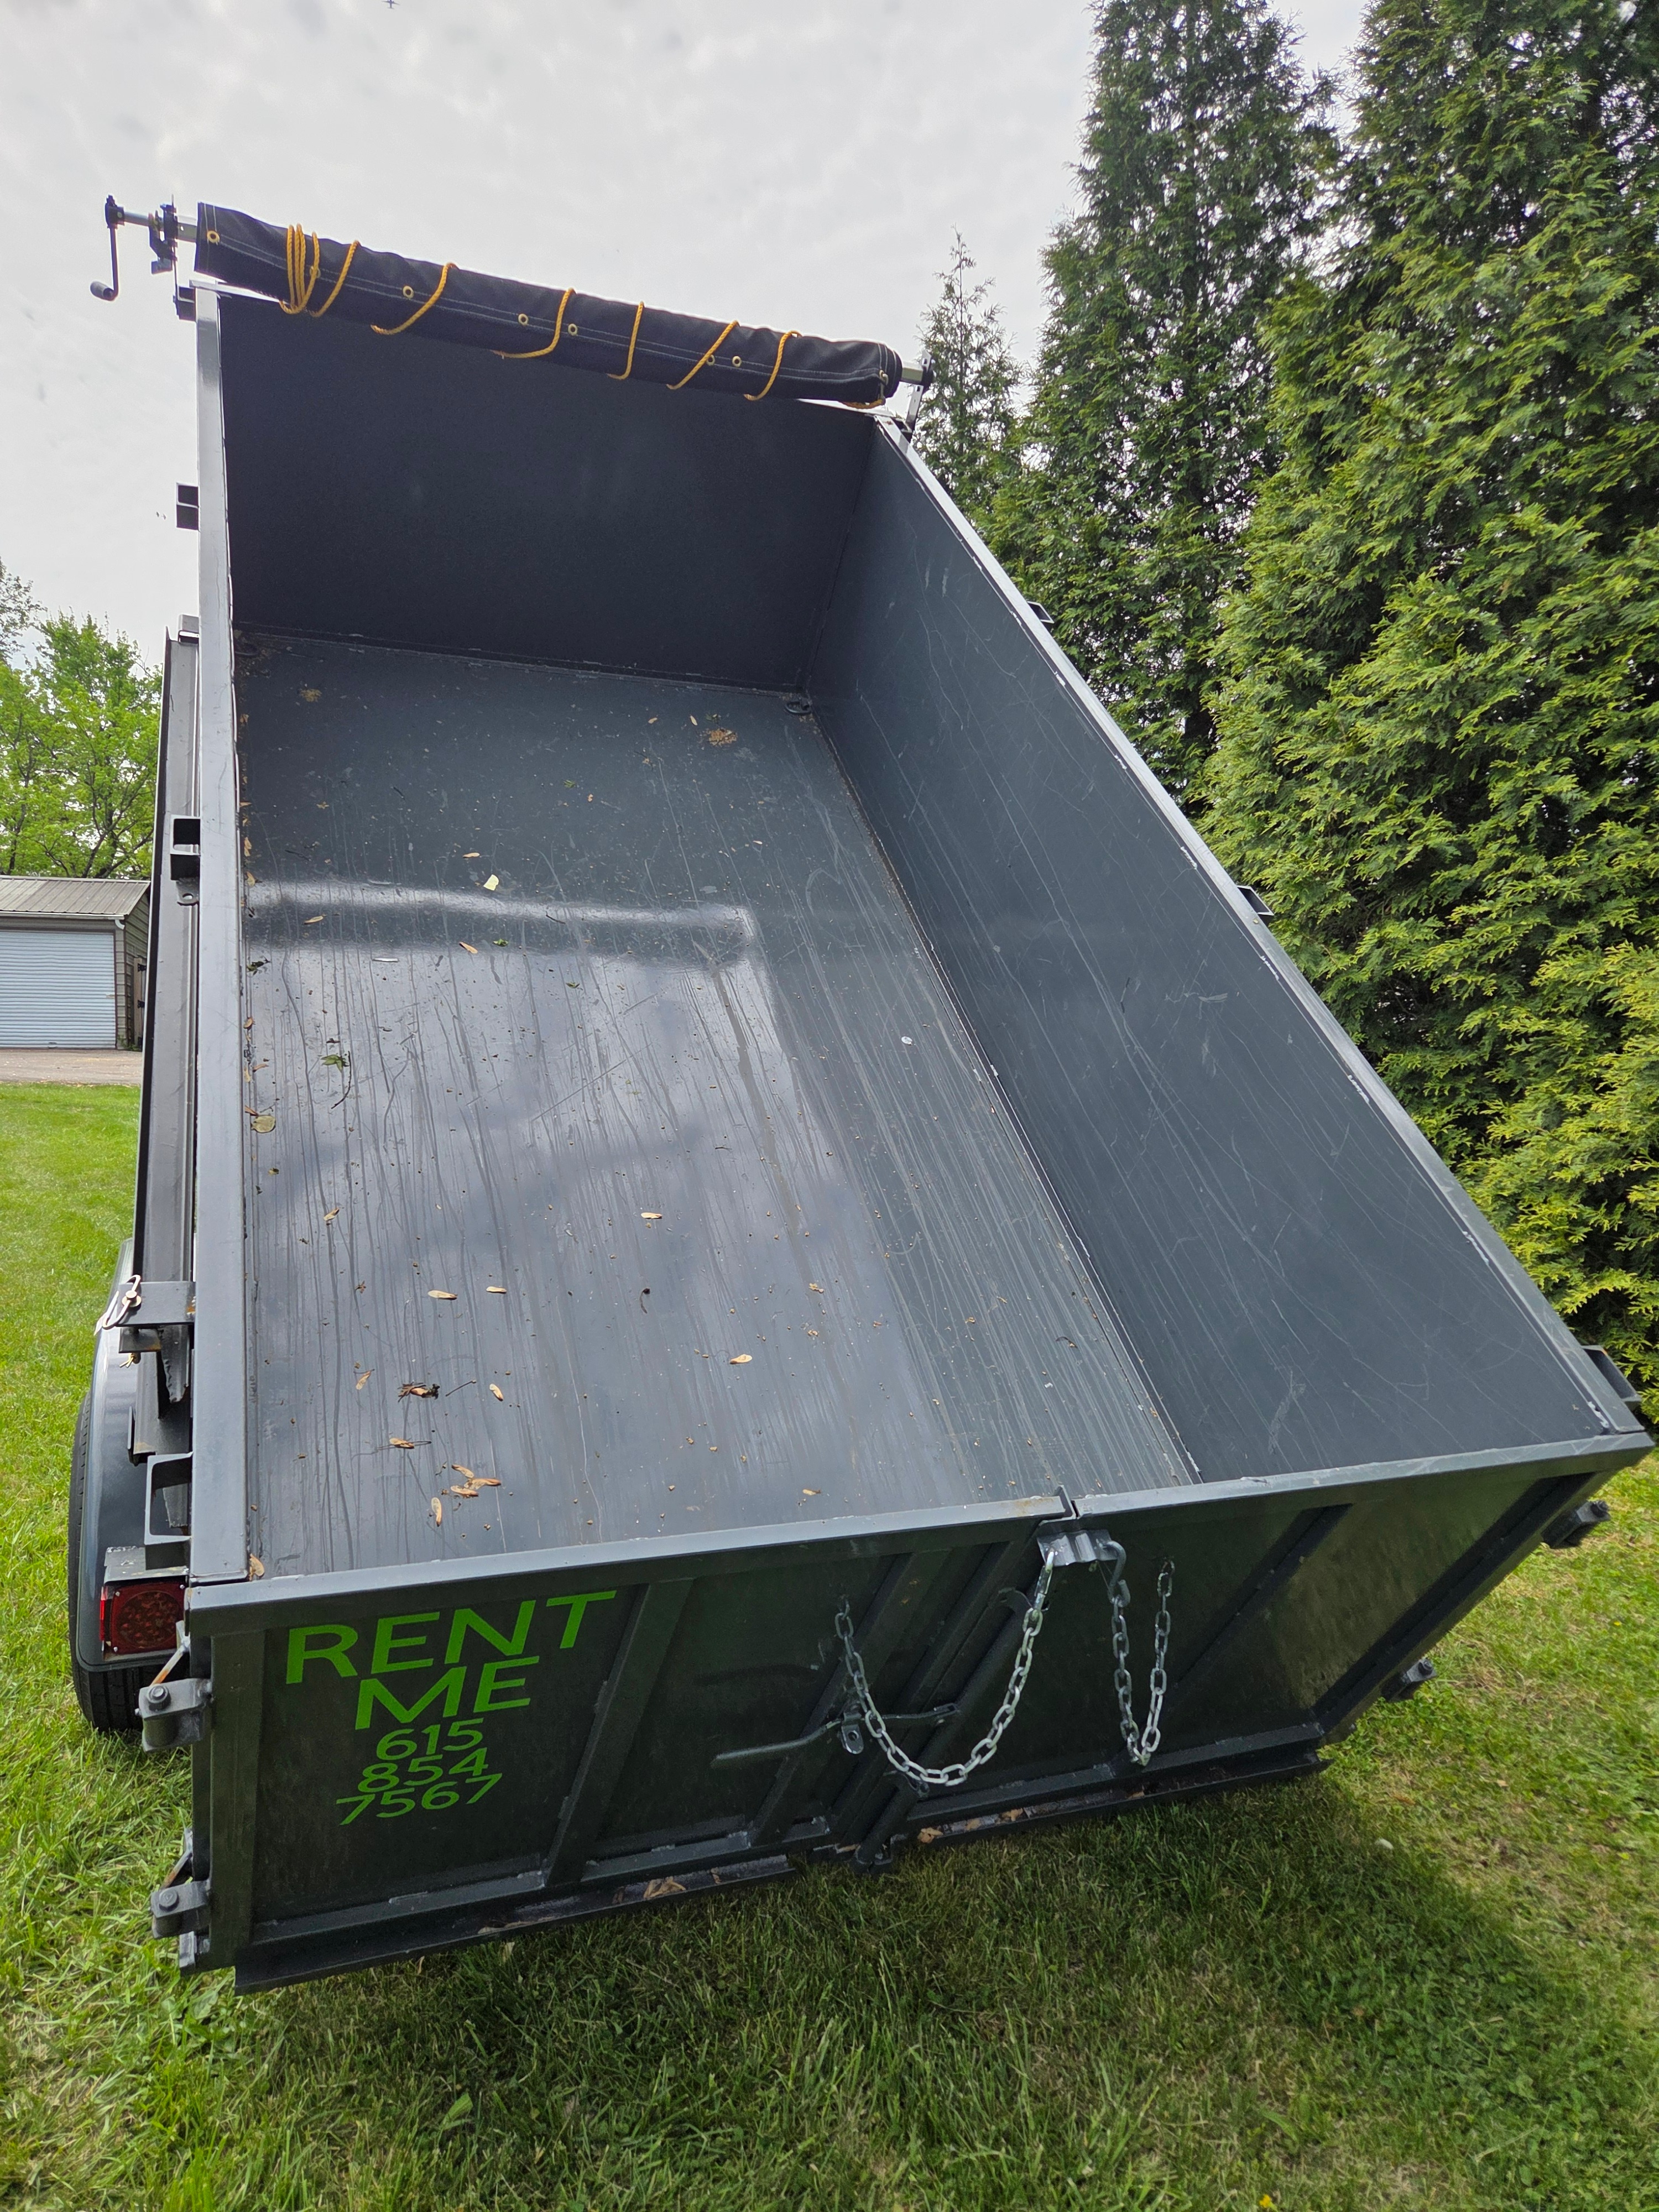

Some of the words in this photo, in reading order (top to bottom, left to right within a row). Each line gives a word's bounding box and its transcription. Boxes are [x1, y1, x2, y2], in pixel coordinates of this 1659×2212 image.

[285, 1589, 617, 1684] RENT
[354, 1655, 540, 1730] ME
[376, 1717, 485, 1761] 615
[358, 1747, 489, 1793] 854
[336, 1772, 503, 1825] 7567
